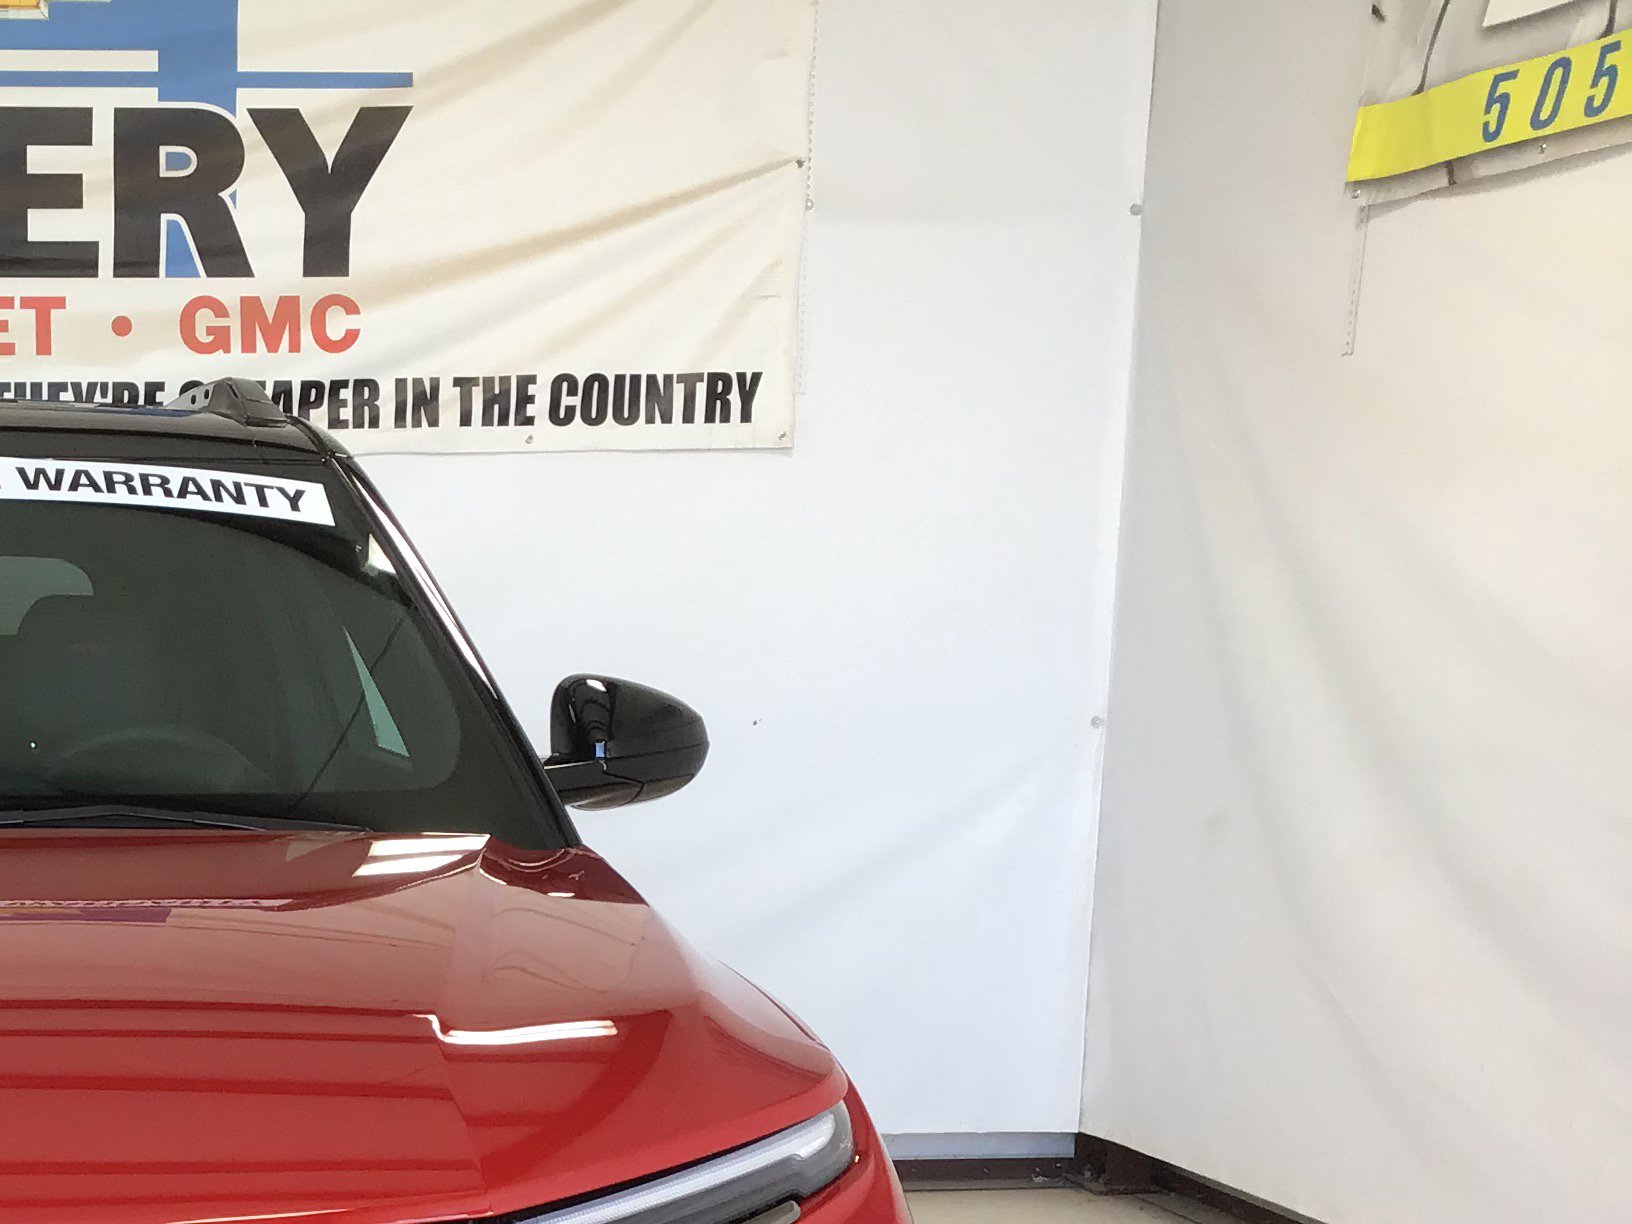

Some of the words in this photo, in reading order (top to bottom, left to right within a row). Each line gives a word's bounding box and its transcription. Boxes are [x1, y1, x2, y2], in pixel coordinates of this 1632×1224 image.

[178, 294, 361, 356] GMC
[394, 377, 441, 429] IN
[453, 374, 537, 428] THE
[548, 371, 764, 427] COUNTRY
[15, 466, 306, 513] WARRANTY
